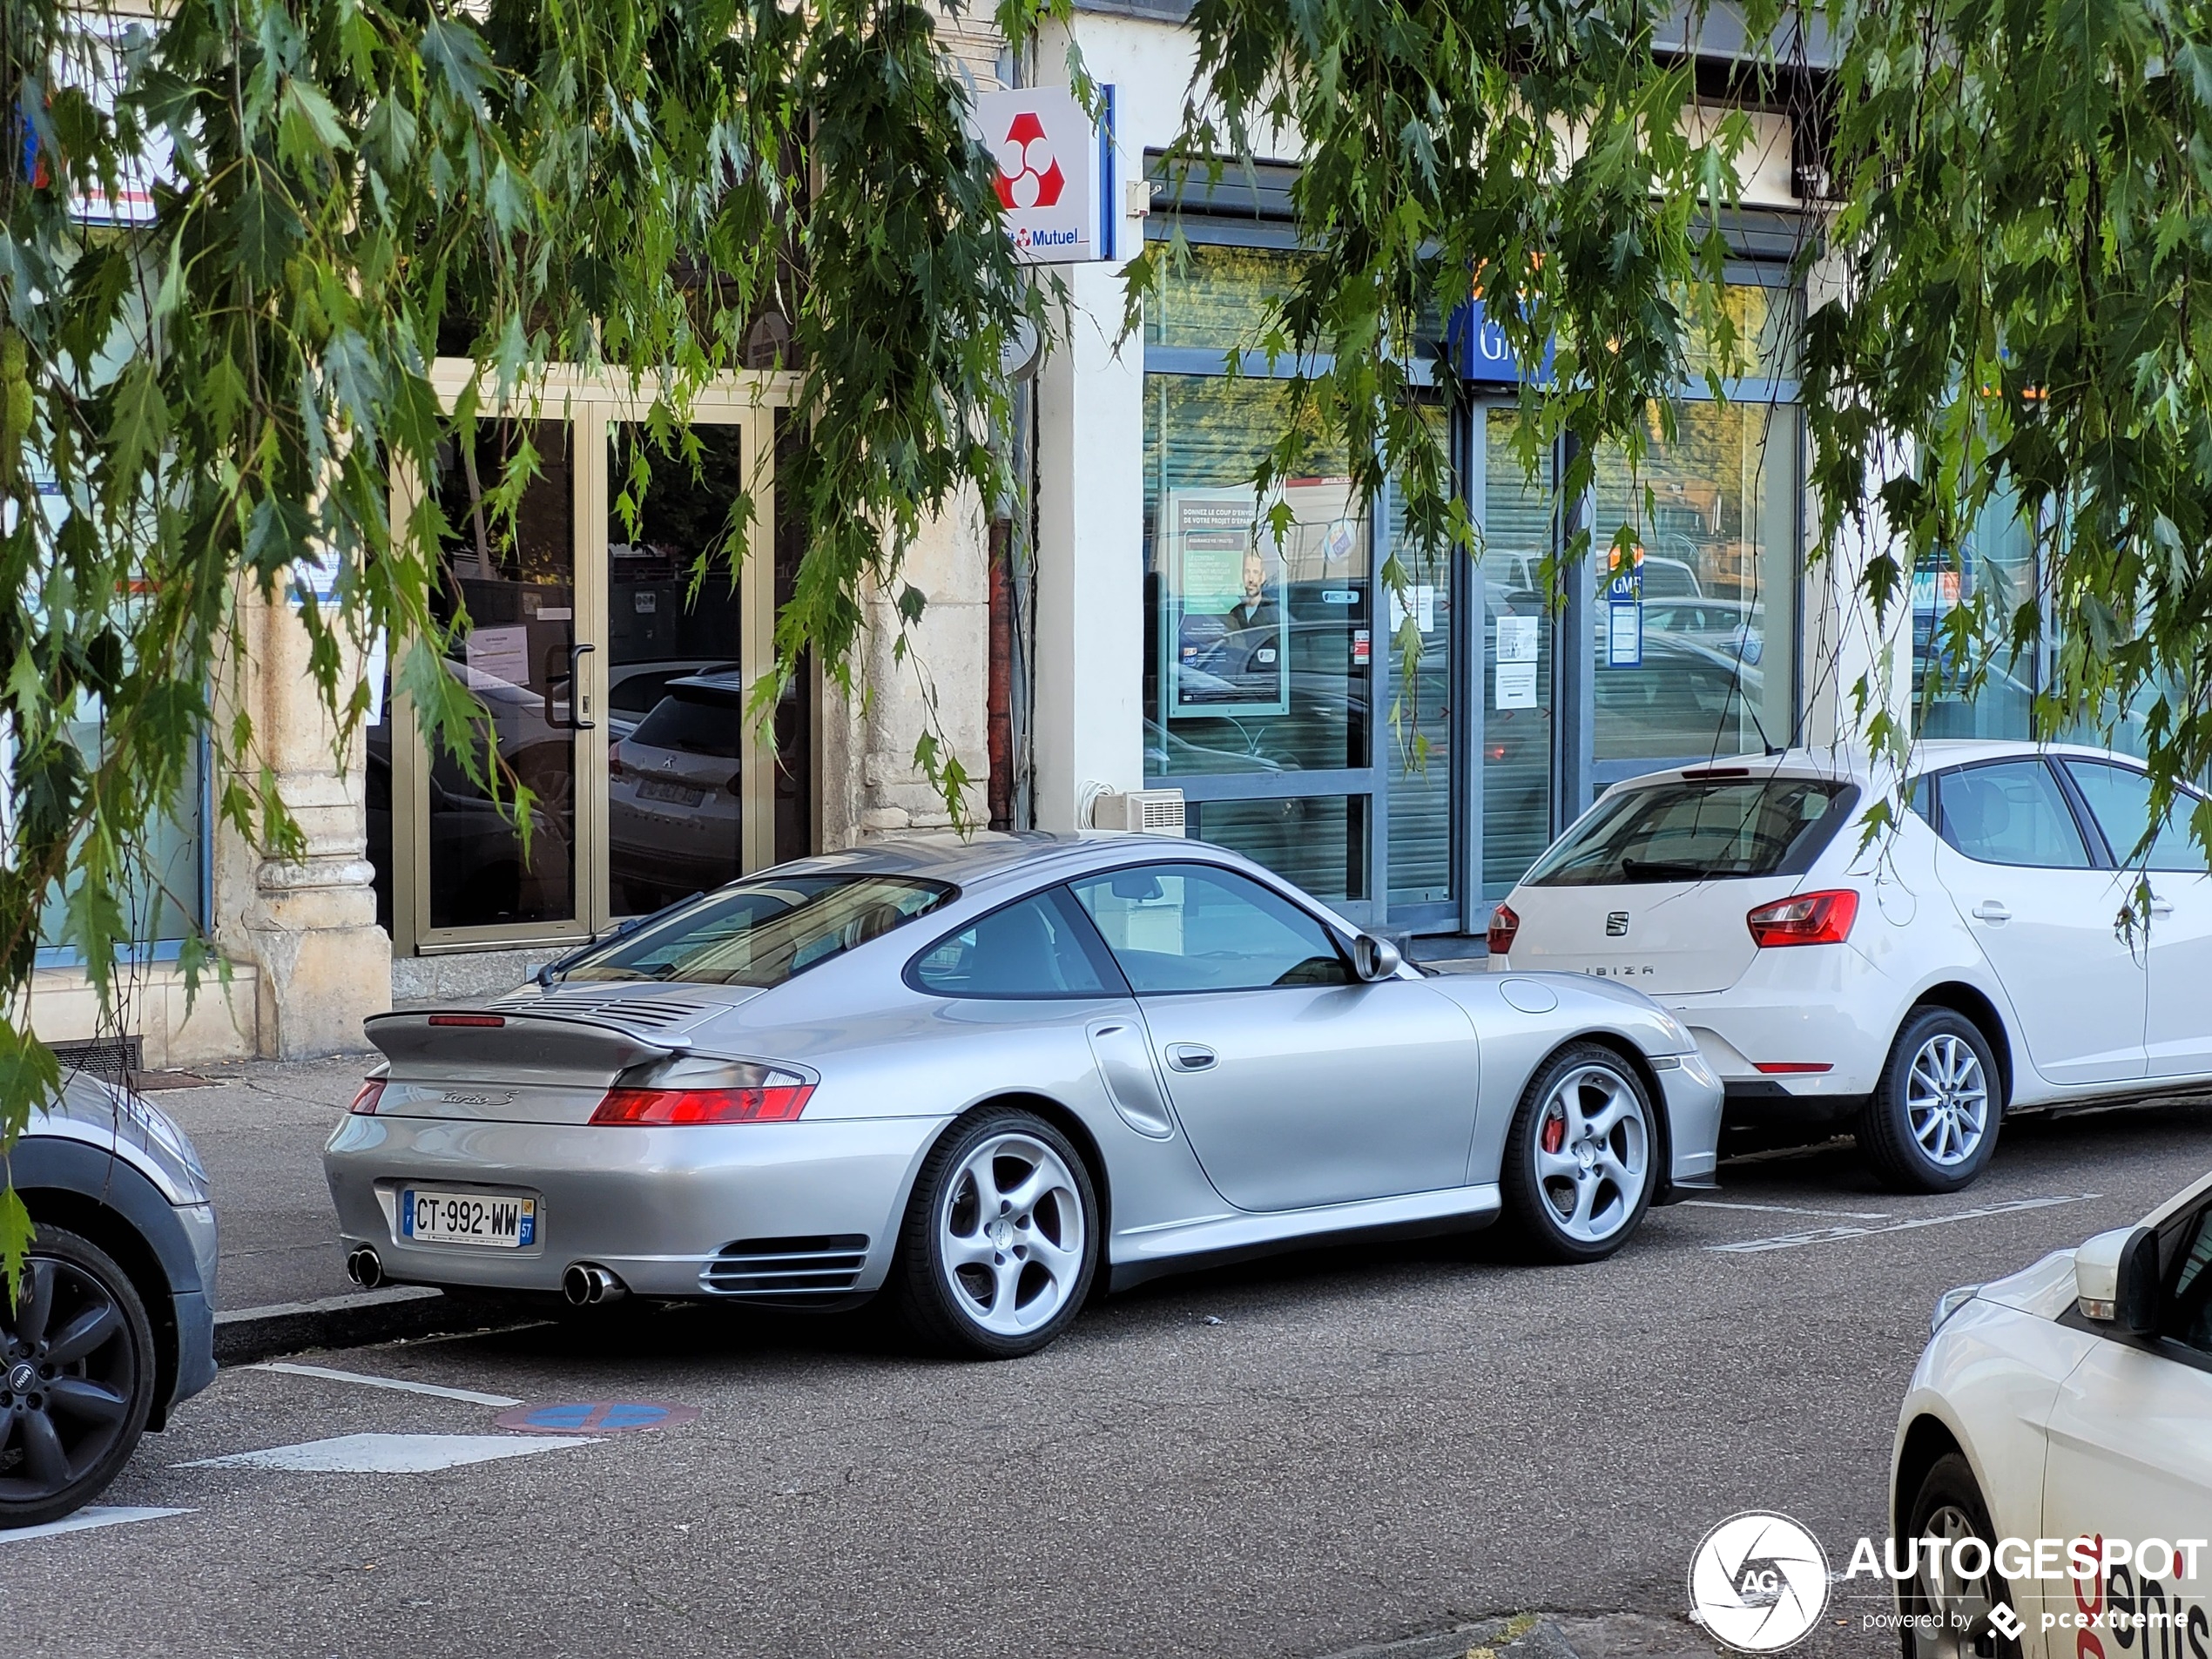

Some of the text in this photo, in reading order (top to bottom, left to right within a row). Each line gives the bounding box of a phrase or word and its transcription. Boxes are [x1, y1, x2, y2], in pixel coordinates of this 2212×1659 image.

[1033, 227, 1078, 246] Mutuel
[1585, 966, 1655, 976] IBIZA
[441, 1090, 521, 1106] turbo S
[406, 1216, 411, 1224] F
[416, 1197, 518, 1236] CT-992-WW
[521, 1224, 531, 1238] 57
[15, 1368, 31, 1388] MINI
